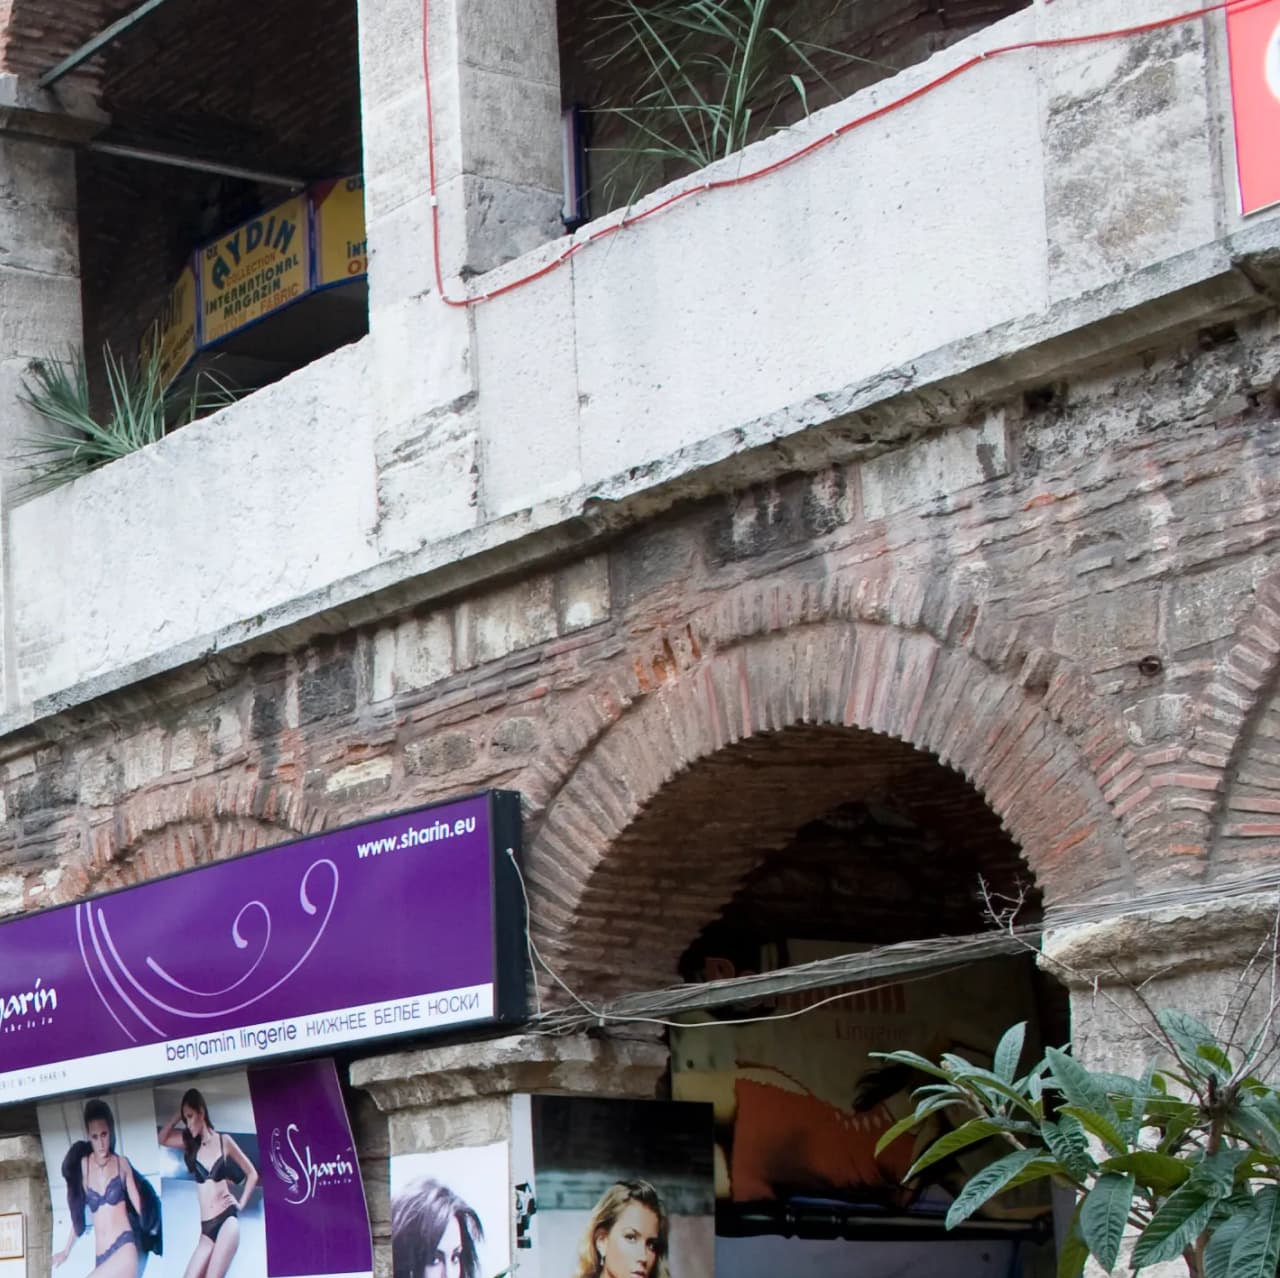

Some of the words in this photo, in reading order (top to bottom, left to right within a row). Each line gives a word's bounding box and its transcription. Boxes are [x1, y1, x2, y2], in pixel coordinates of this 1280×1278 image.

[211, 215, 296, 289] AYDIN
[356, 816, 476, 859] www.sharin.eu
[306, 1012, 367, 1037] НИЖНЕЕ
[428, 993, 480, 1017] НОСКИ
[166, 1032, 236, 1062] benjamin
[240, 1022, 297, 1051] lingerie
[284, 1123, 353, 1205] Sharin
